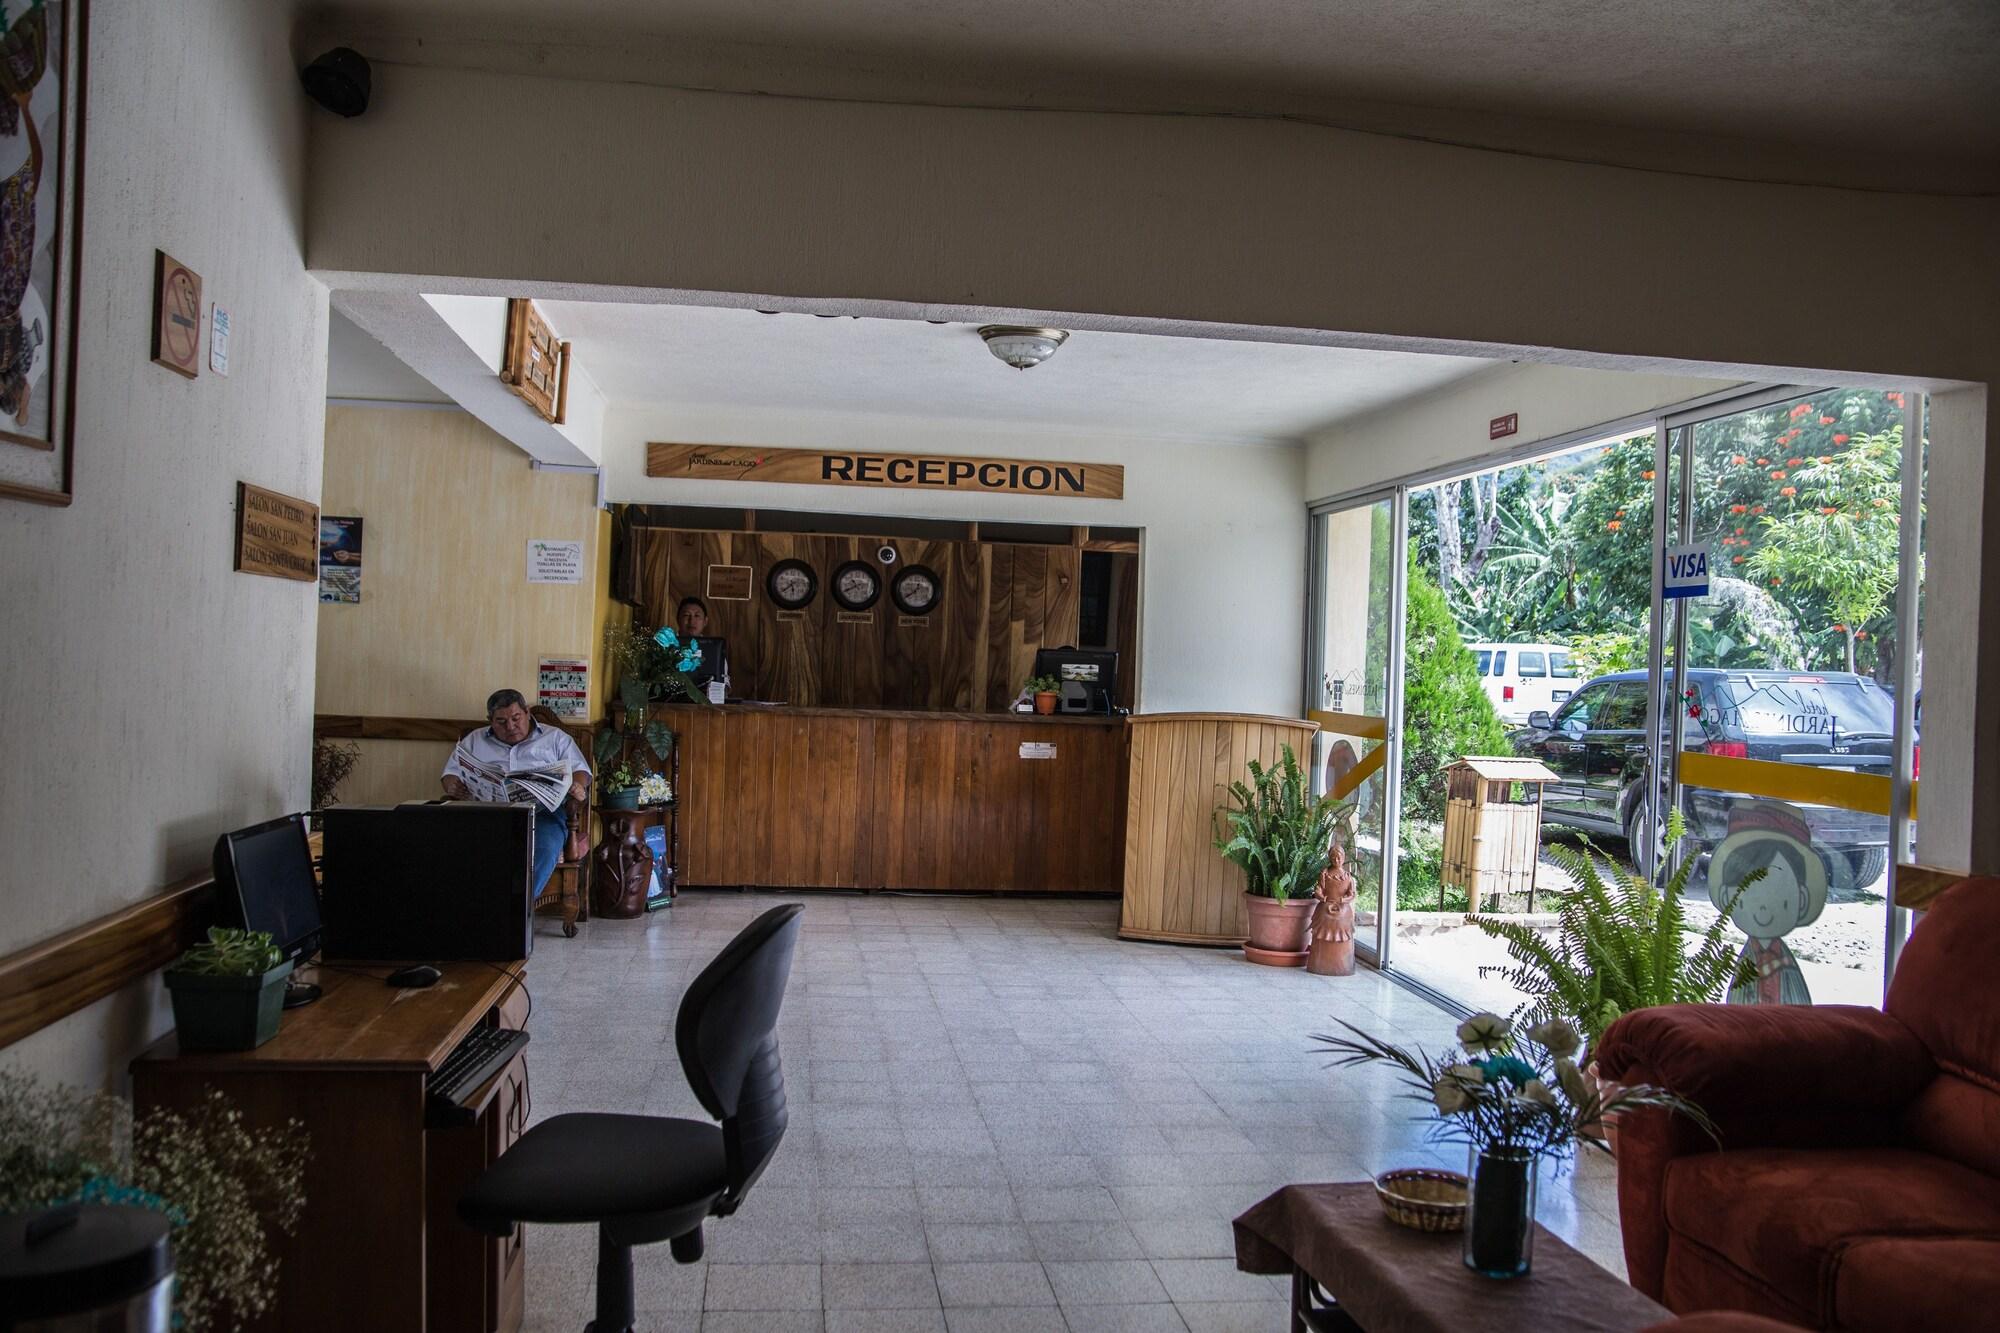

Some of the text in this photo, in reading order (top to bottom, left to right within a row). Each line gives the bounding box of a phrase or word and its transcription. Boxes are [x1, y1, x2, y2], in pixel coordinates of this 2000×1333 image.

[821, 455, 1085, 492] RECEPCION
[248, 495, 269, 513] SALON
[270, 500, 283, 518] SAN
[247, 520, 298, 545] SALON SAN JUAN
[245, 545, 267, 564] SALON
[1668, 552, 1707, 578] VISA
